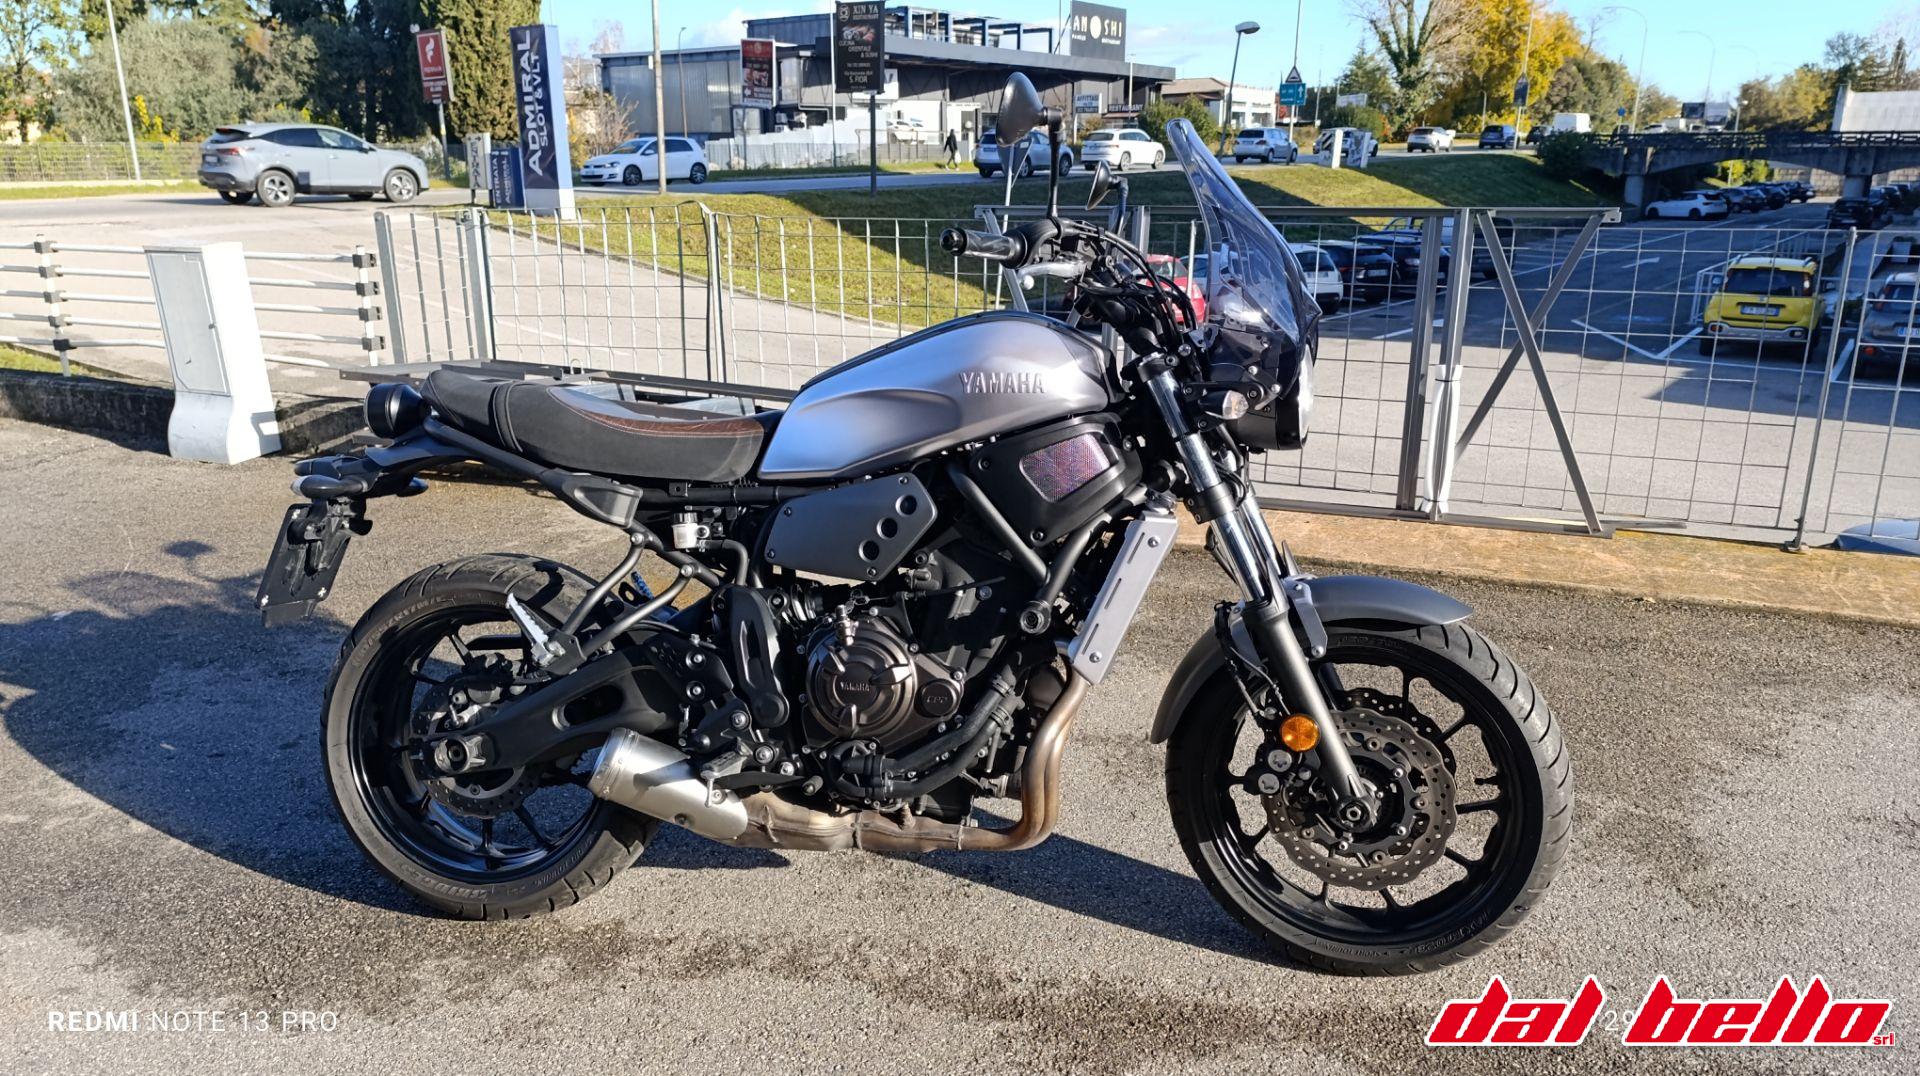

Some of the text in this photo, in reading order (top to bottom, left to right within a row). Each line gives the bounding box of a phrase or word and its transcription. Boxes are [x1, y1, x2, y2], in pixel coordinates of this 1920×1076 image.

[853, 5, 879, 15] XIN YA
[517, 30, 543, 177] ADMIRAL
[530, 54, 548, 147] SLOT & VLT
[491, 158, 502, 204] ENTRATA
[959, 371, 1046, 394] YAMAHA
[840, 681, 870, 692] YAMAHA
